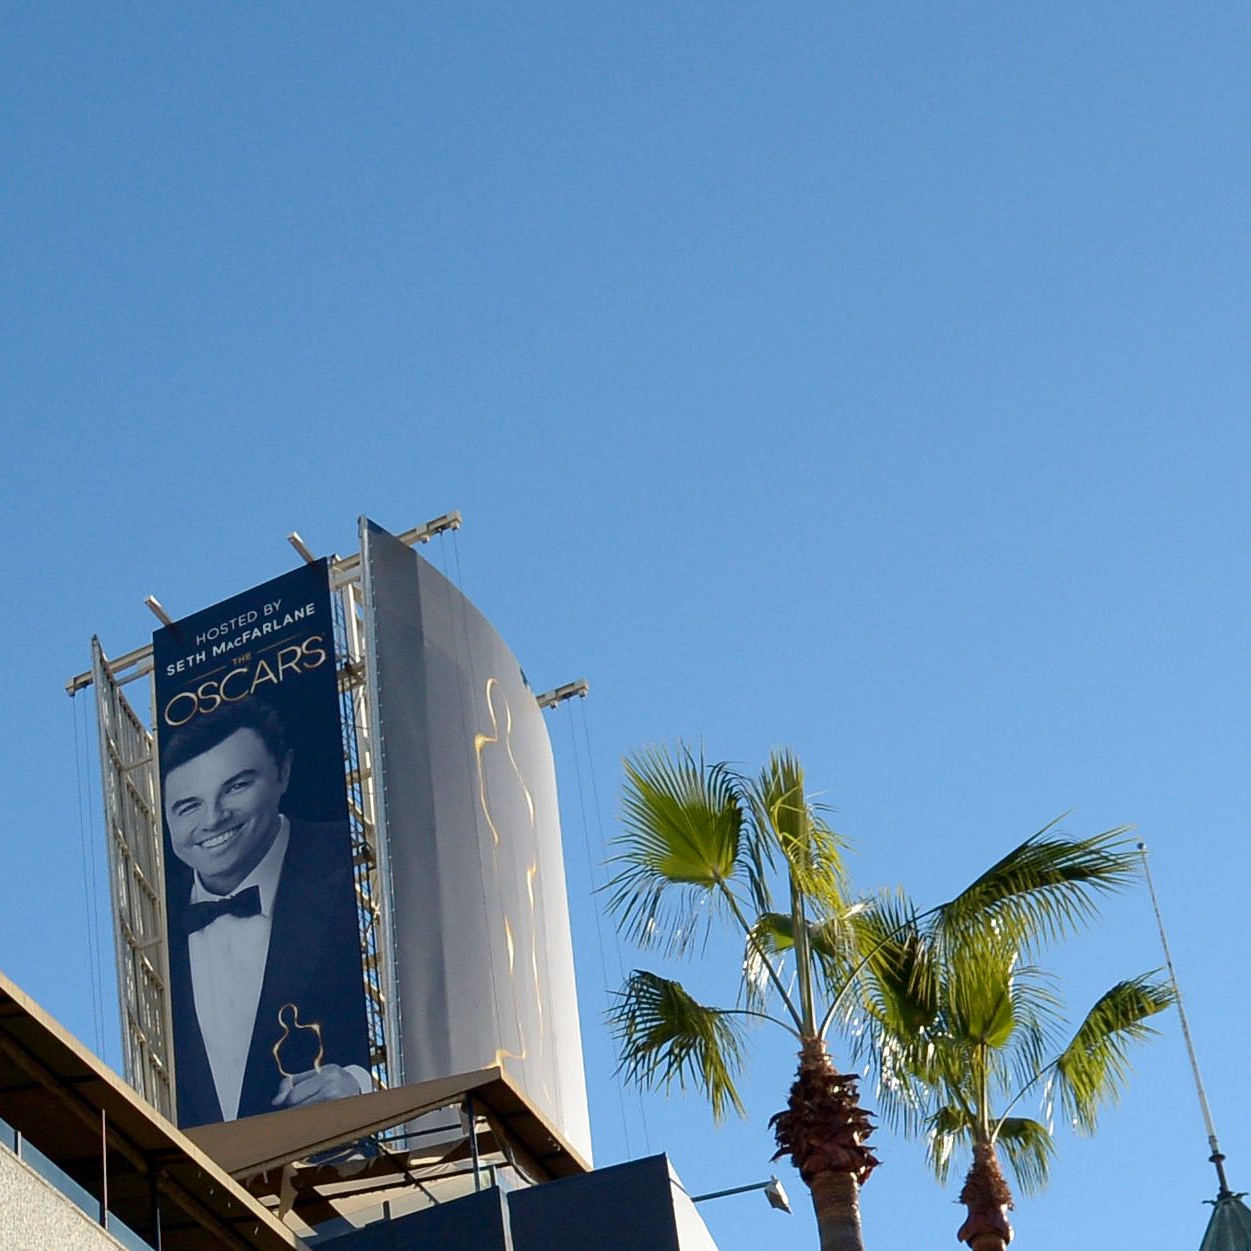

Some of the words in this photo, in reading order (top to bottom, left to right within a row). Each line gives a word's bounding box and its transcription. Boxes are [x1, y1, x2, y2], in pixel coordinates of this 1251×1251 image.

[195, 610, 259, 647] HOSTED
[263, 599, 282, 618] BY
[166, 652, 207, 677] SETH
[232, 652, 252, 665] THE
[164, 635, 327, 726] OSCARS
